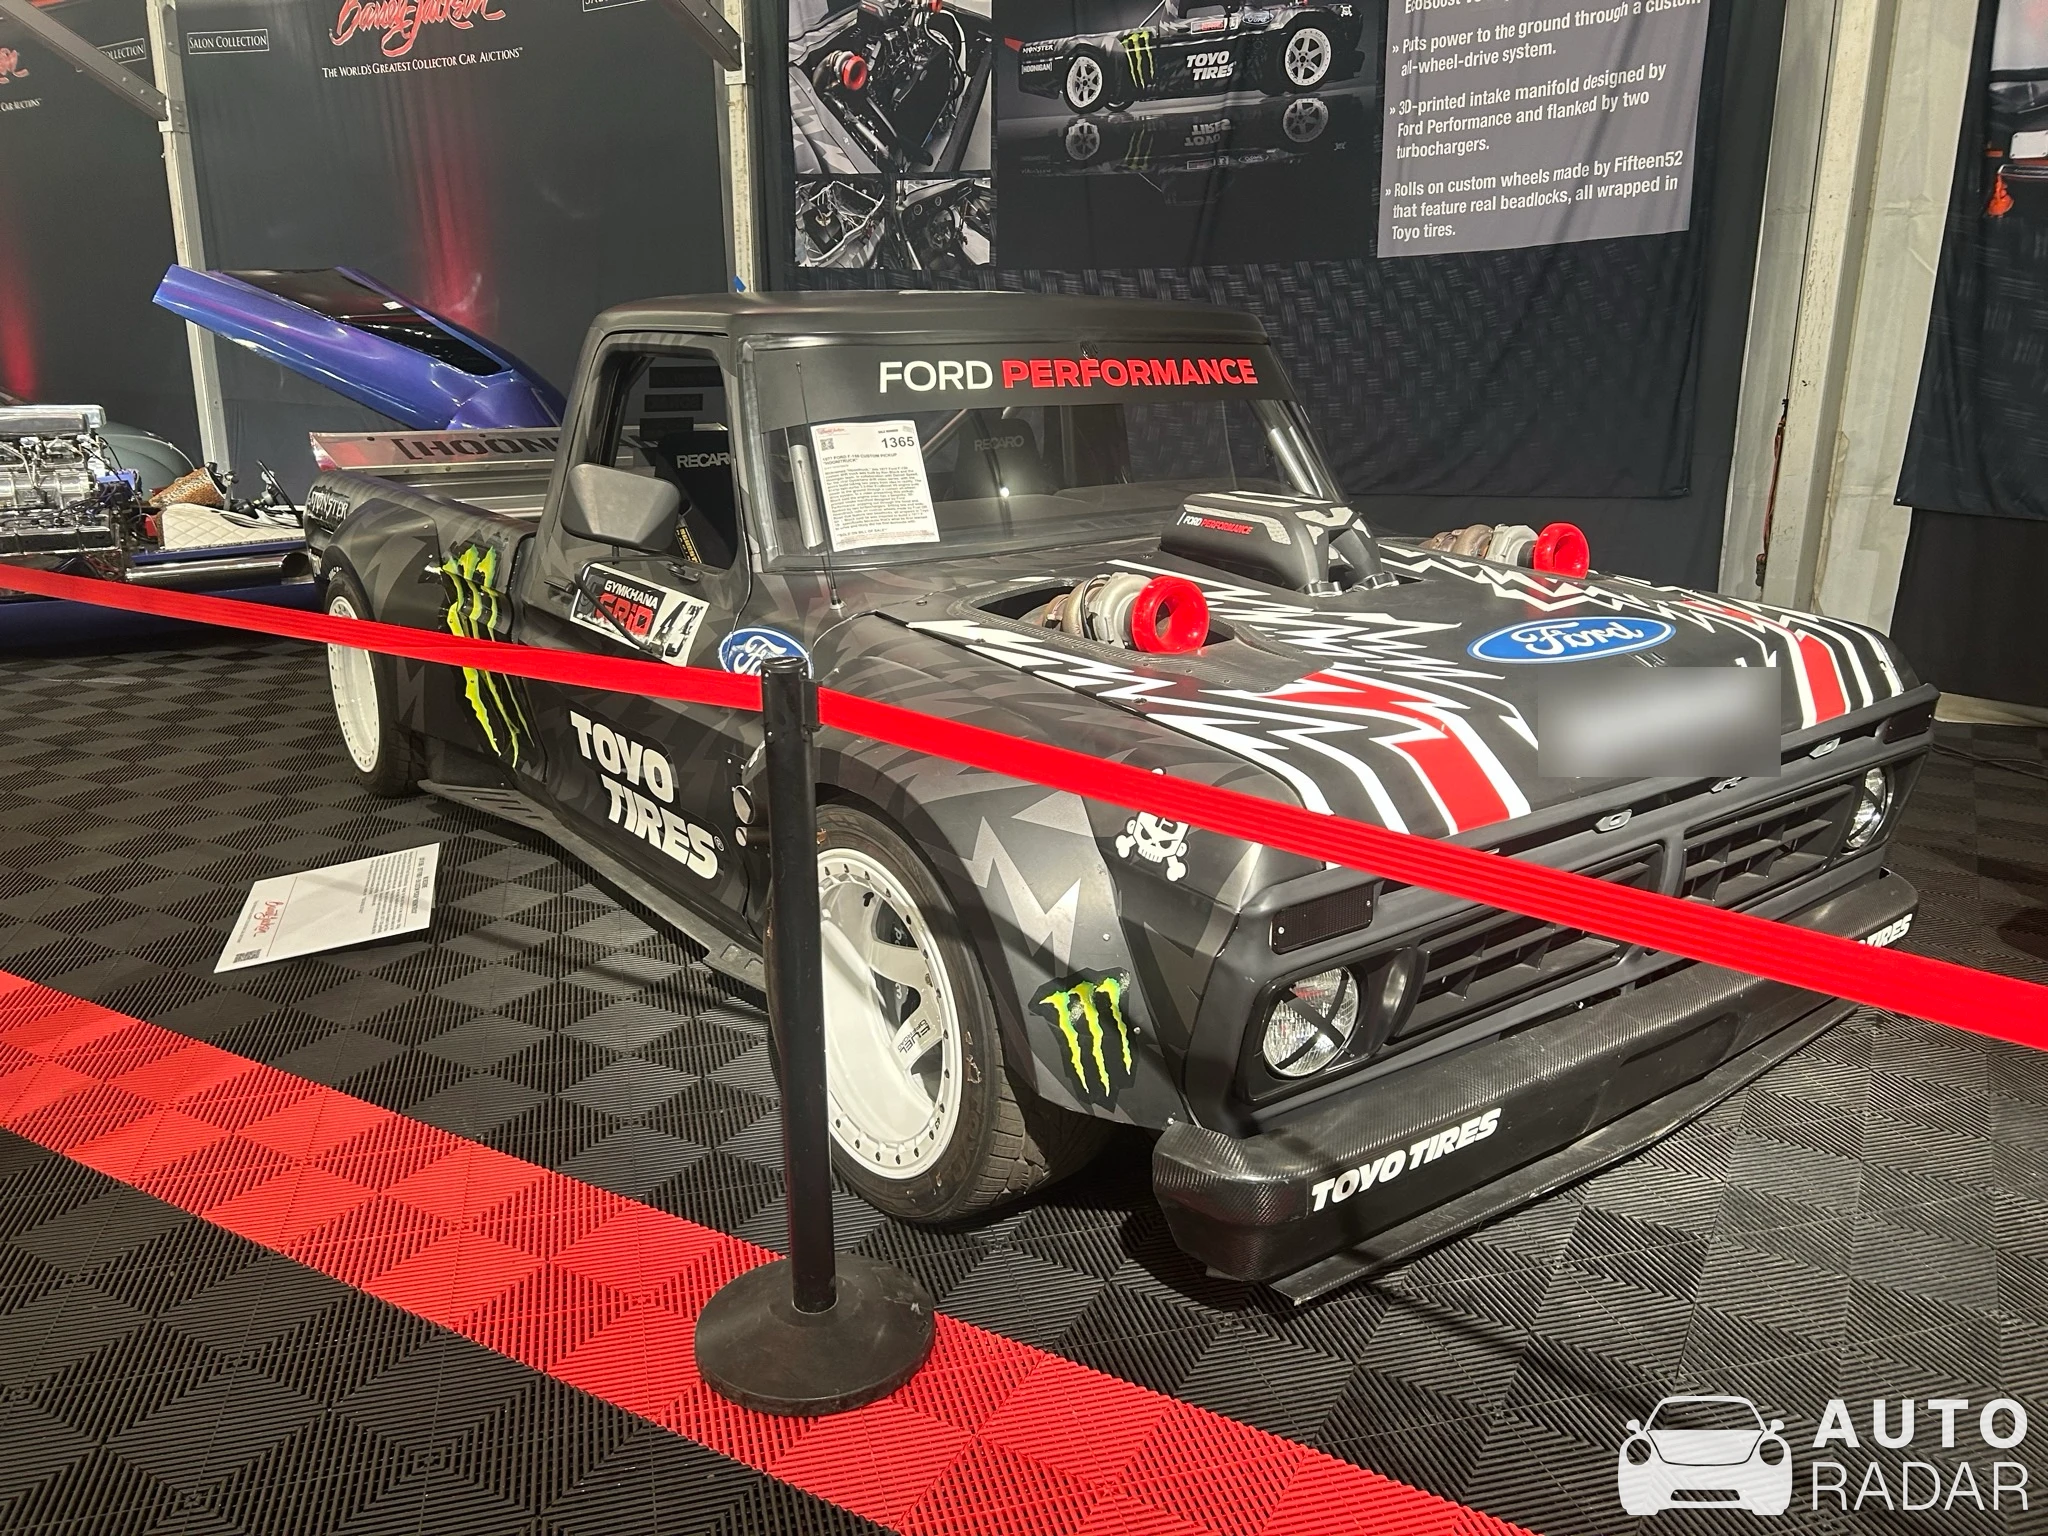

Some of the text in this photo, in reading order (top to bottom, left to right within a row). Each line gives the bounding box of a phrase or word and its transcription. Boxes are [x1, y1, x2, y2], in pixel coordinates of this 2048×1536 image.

[189, 35, 267, 49] SALON COLLECTION
[1402, 36, 1427, 54] Puts
[1430, 31, 1474, 52] power
[1477, 28, 1491, 42] to
[1495, 23, 1516, 40] the
[1518, 12, 1570, 38] ground
[1574, 3, 1629, 27] through
[1633, 1, 1642, 14] a
[321, 67, 338, 78] THE
[339, 63, 372, 77] WORLD'S
[372, 62, 411, 74] GREATEST
[412, 55, 457, 70] COLLECTOR
[459, 53, 477, 65] CAR
[1186, 50, 1230, 68] TOYO
[1192, 61, 1237, 80] TIRES
[1401, 42, 1557, 76] all-wheel-drive system.
[1398, 62, 1667, 116] 3D-printed intake manifold designed by
[1397, 91, 1650, 137] Ford Performance and flanked by two
[1396, 138, 1490, 159] turbochargers.
[1394, 150, 1684, 198] Rolls on custom wheels made by Fifteen52
[1392, 175, 1679, 219] that feature real beadlocks, all wrapped in
[1391, 223, 1456, 242] Toyo tires.
[879, 358, 1259, 393] FORD PERFORMANCE
[881, 436, 915, 449] 1365
[974, 435, 1025, 451] RECARO
[676, 452, 731, 468] RECAR
[1182, 515, 1254, 535] FORD PERFORMANCE
[603, 579, 659, 610] GYMKHANA
[1511, 621, 1645, 657] Ford
[569, 710, 674, 803] TOYO
[1311, 1107, 1502, 1212] TOYO TIRES
